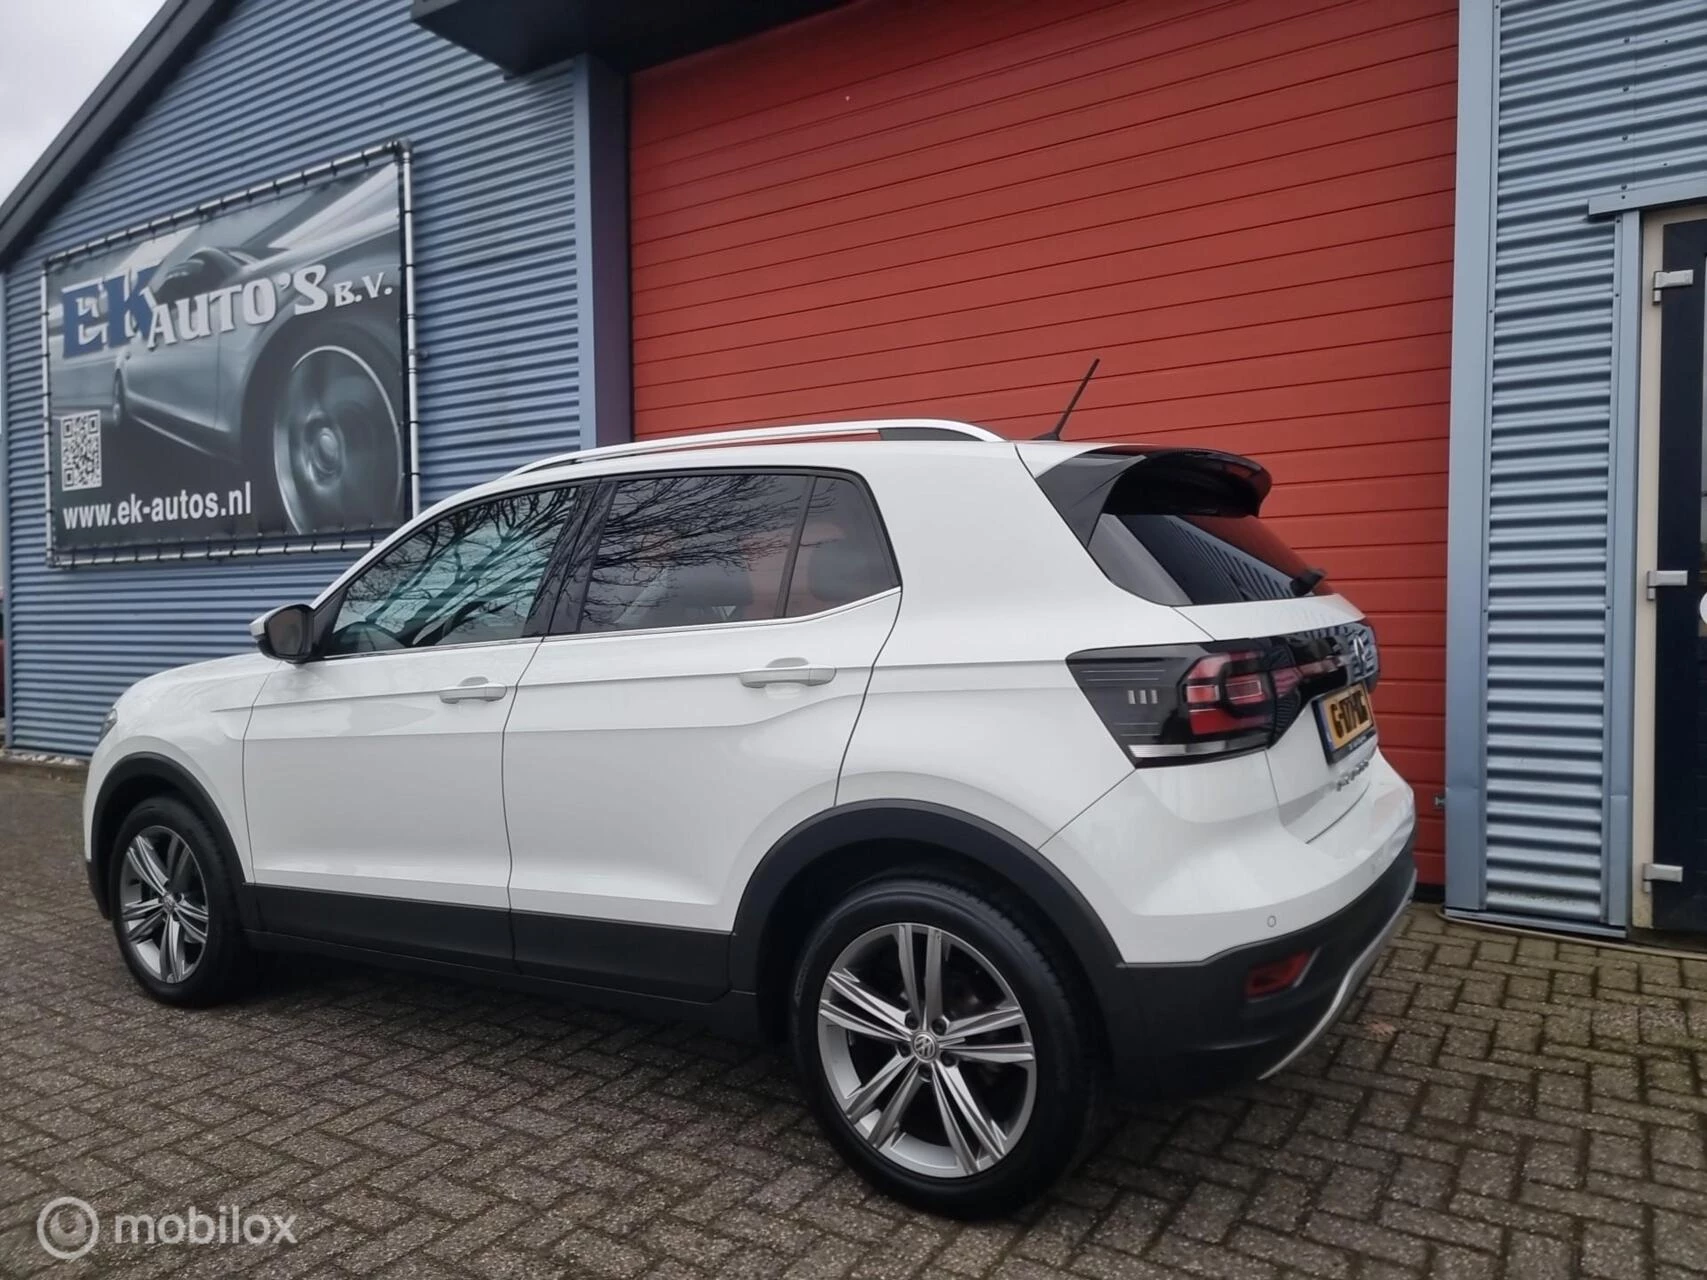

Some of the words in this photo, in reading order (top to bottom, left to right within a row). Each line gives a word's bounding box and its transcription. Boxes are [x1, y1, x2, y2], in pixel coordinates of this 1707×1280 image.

[61, 265, 157, 358] EK
[145, 263, 329, 350] AUTO'S
[333, 271, 394, 308] B.V.
[62, 480, 252, 531] www.ek-autos.nl
